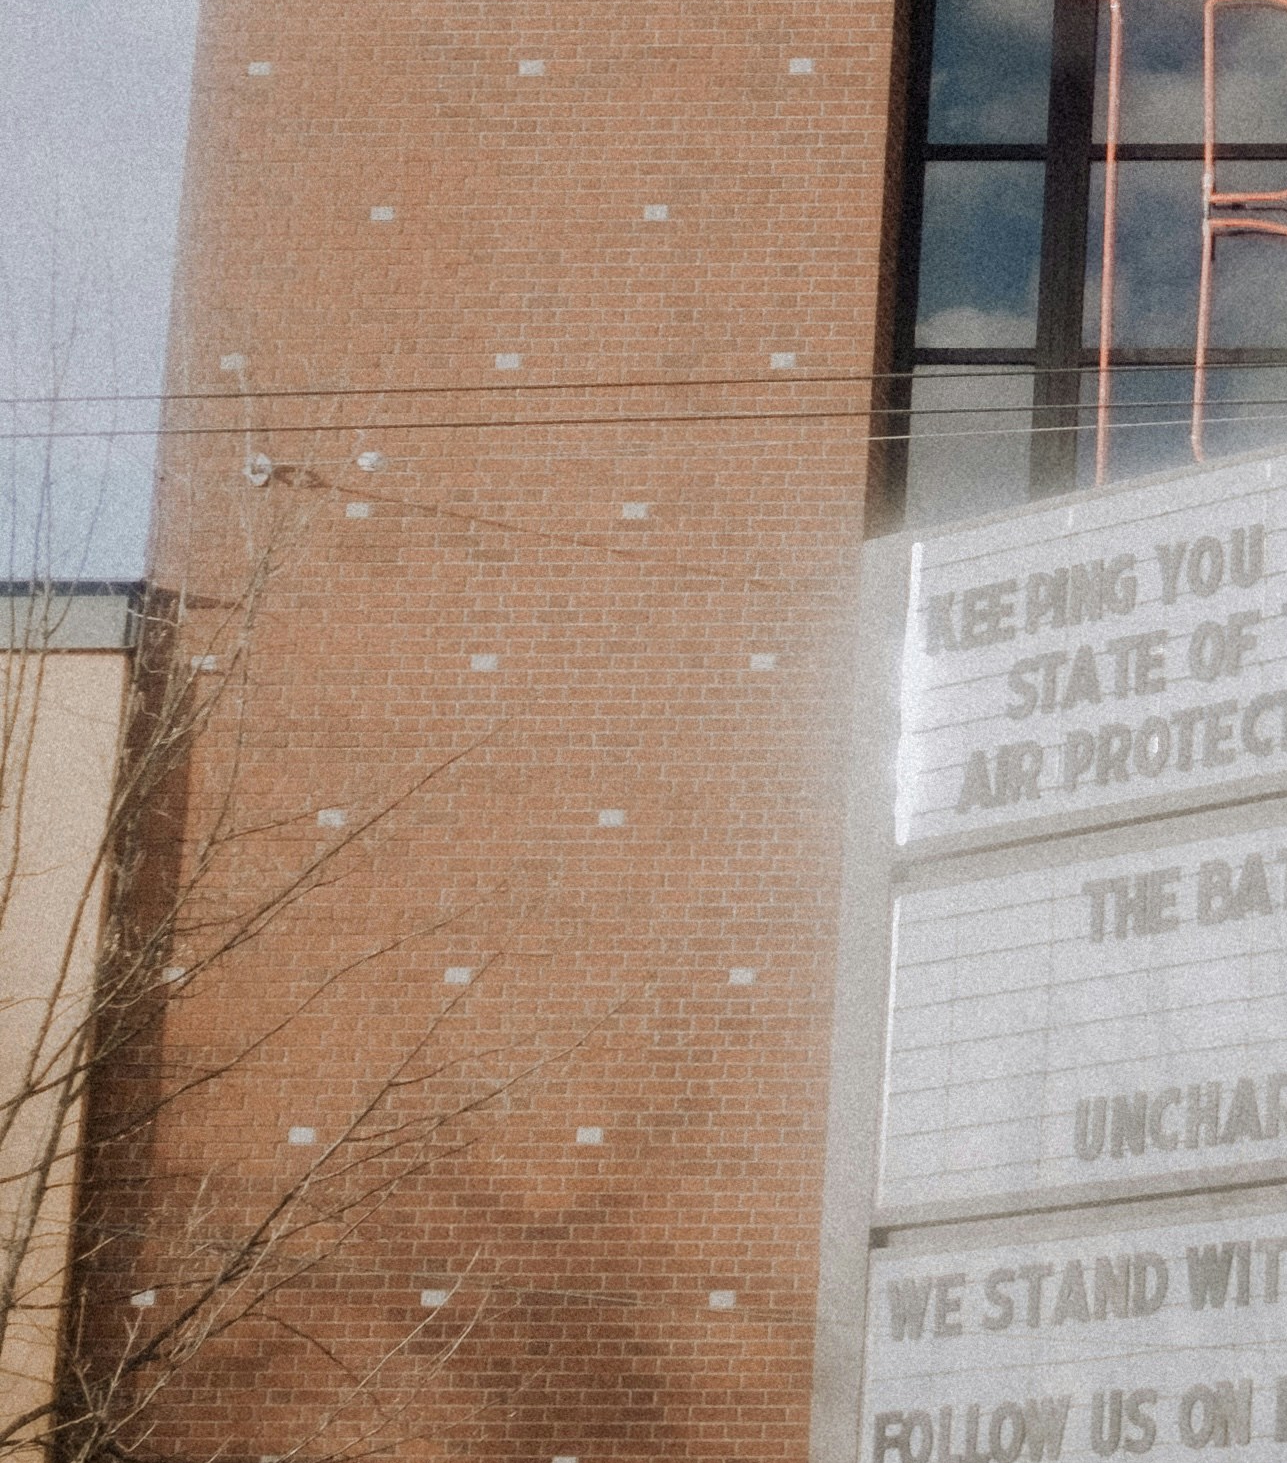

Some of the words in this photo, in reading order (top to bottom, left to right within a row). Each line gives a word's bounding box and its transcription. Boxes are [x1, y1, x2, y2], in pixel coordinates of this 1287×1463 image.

[925, 554, 1136, 655] KEEPING
[1154, 524, 1264, 605] YOU
[1006, 629, 1166, 719] STATE
[1189, 611, 1260, 681] OF
[956, 740, 1043, 814] AIR
[1088, 867, 1181, 944] THE
[886, 1273, 963, 1342] WE
[981, 1251, 1169, 1332] STAND
[1089, 1387, 1157, 1455] US
[1178, 1379, 1253, 1448] ON
